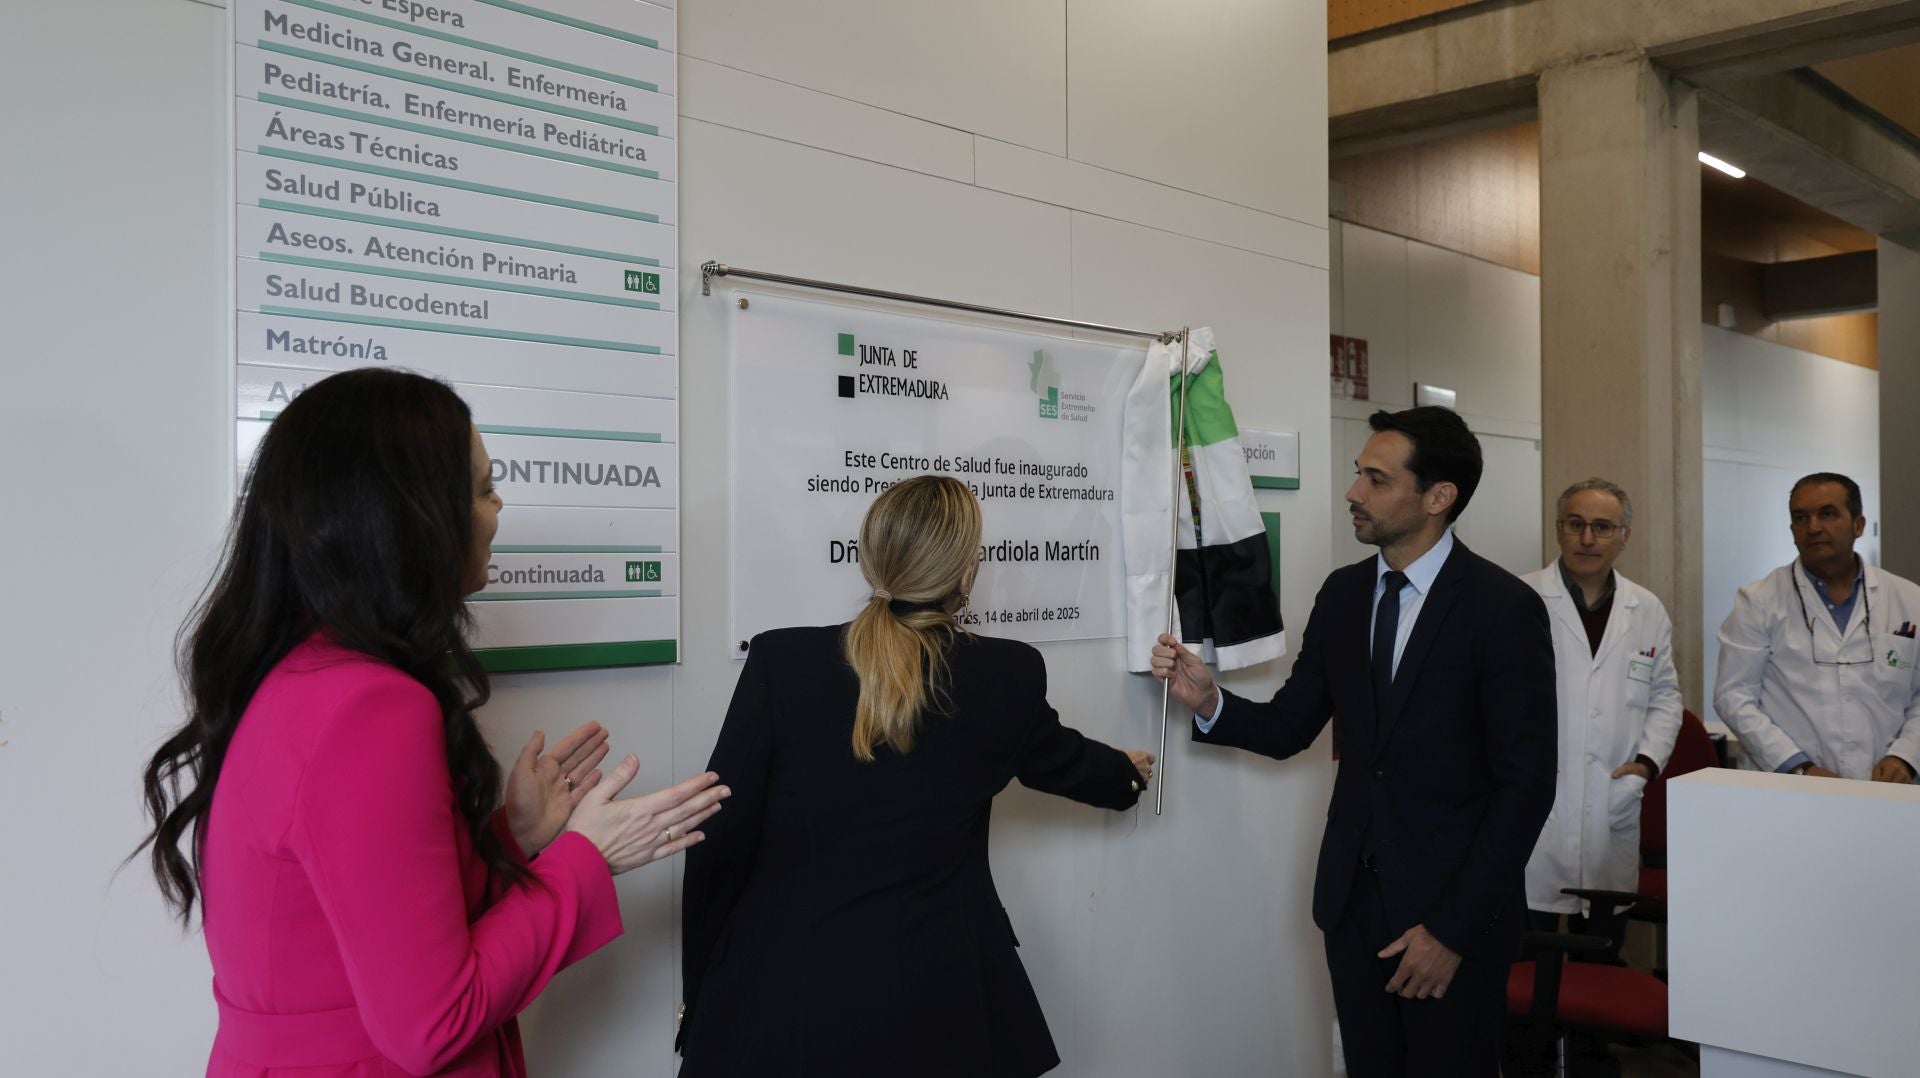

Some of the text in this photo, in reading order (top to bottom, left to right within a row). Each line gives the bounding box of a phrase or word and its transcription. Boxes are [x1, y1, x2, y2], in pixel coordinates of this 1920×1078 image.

[265, 10, 627, 111] Medicina General. Enfermería
[265, 63, 647, 161] Pediatría. Enfermería Pediátrica
[266, 113, 458, 170] Áreas Técnicas
[266, 169, 440, 217] Salud Pública
[267, 223, 577, 283] Aseos. Atención Primaria
[266, 275, 488, 319] Salud Bucodental
[267, 329, 387, 360] Matrón/a
[859, 344, 917, 369] JUNTA DE
[860, 374, 948, 400] EXTREMADURA
[1061, 392, 1085, 401] Servicio
[1040, 403, 1058, 416] SES
[1061, 402, 1095, 412] Extremeño
[1061, 412, 1087, 422] de Salud
[491, 459, 661, 487] ONTINUADA
[846, 451, 1087, 481] Este Centro de Salud fue inaugurado
[808, 475, 859, 493] siendo
[981, 482, 1015, 500] Junta
[1020, 483, 1034, 498] de
[1039, 484, 1113, 500] Extremadura
[831, 540, 1099, 563] Dñ ardiola Martín
[488, 564, 605, 584] Continuada
[985, 611, 997, 623] 14
[1000, 610, 1013, 622] de
[1016, 608, 1038, 622] abril
[1042, 608, 1054, 620] de
[1057, 607, 1079, 619] 2025
